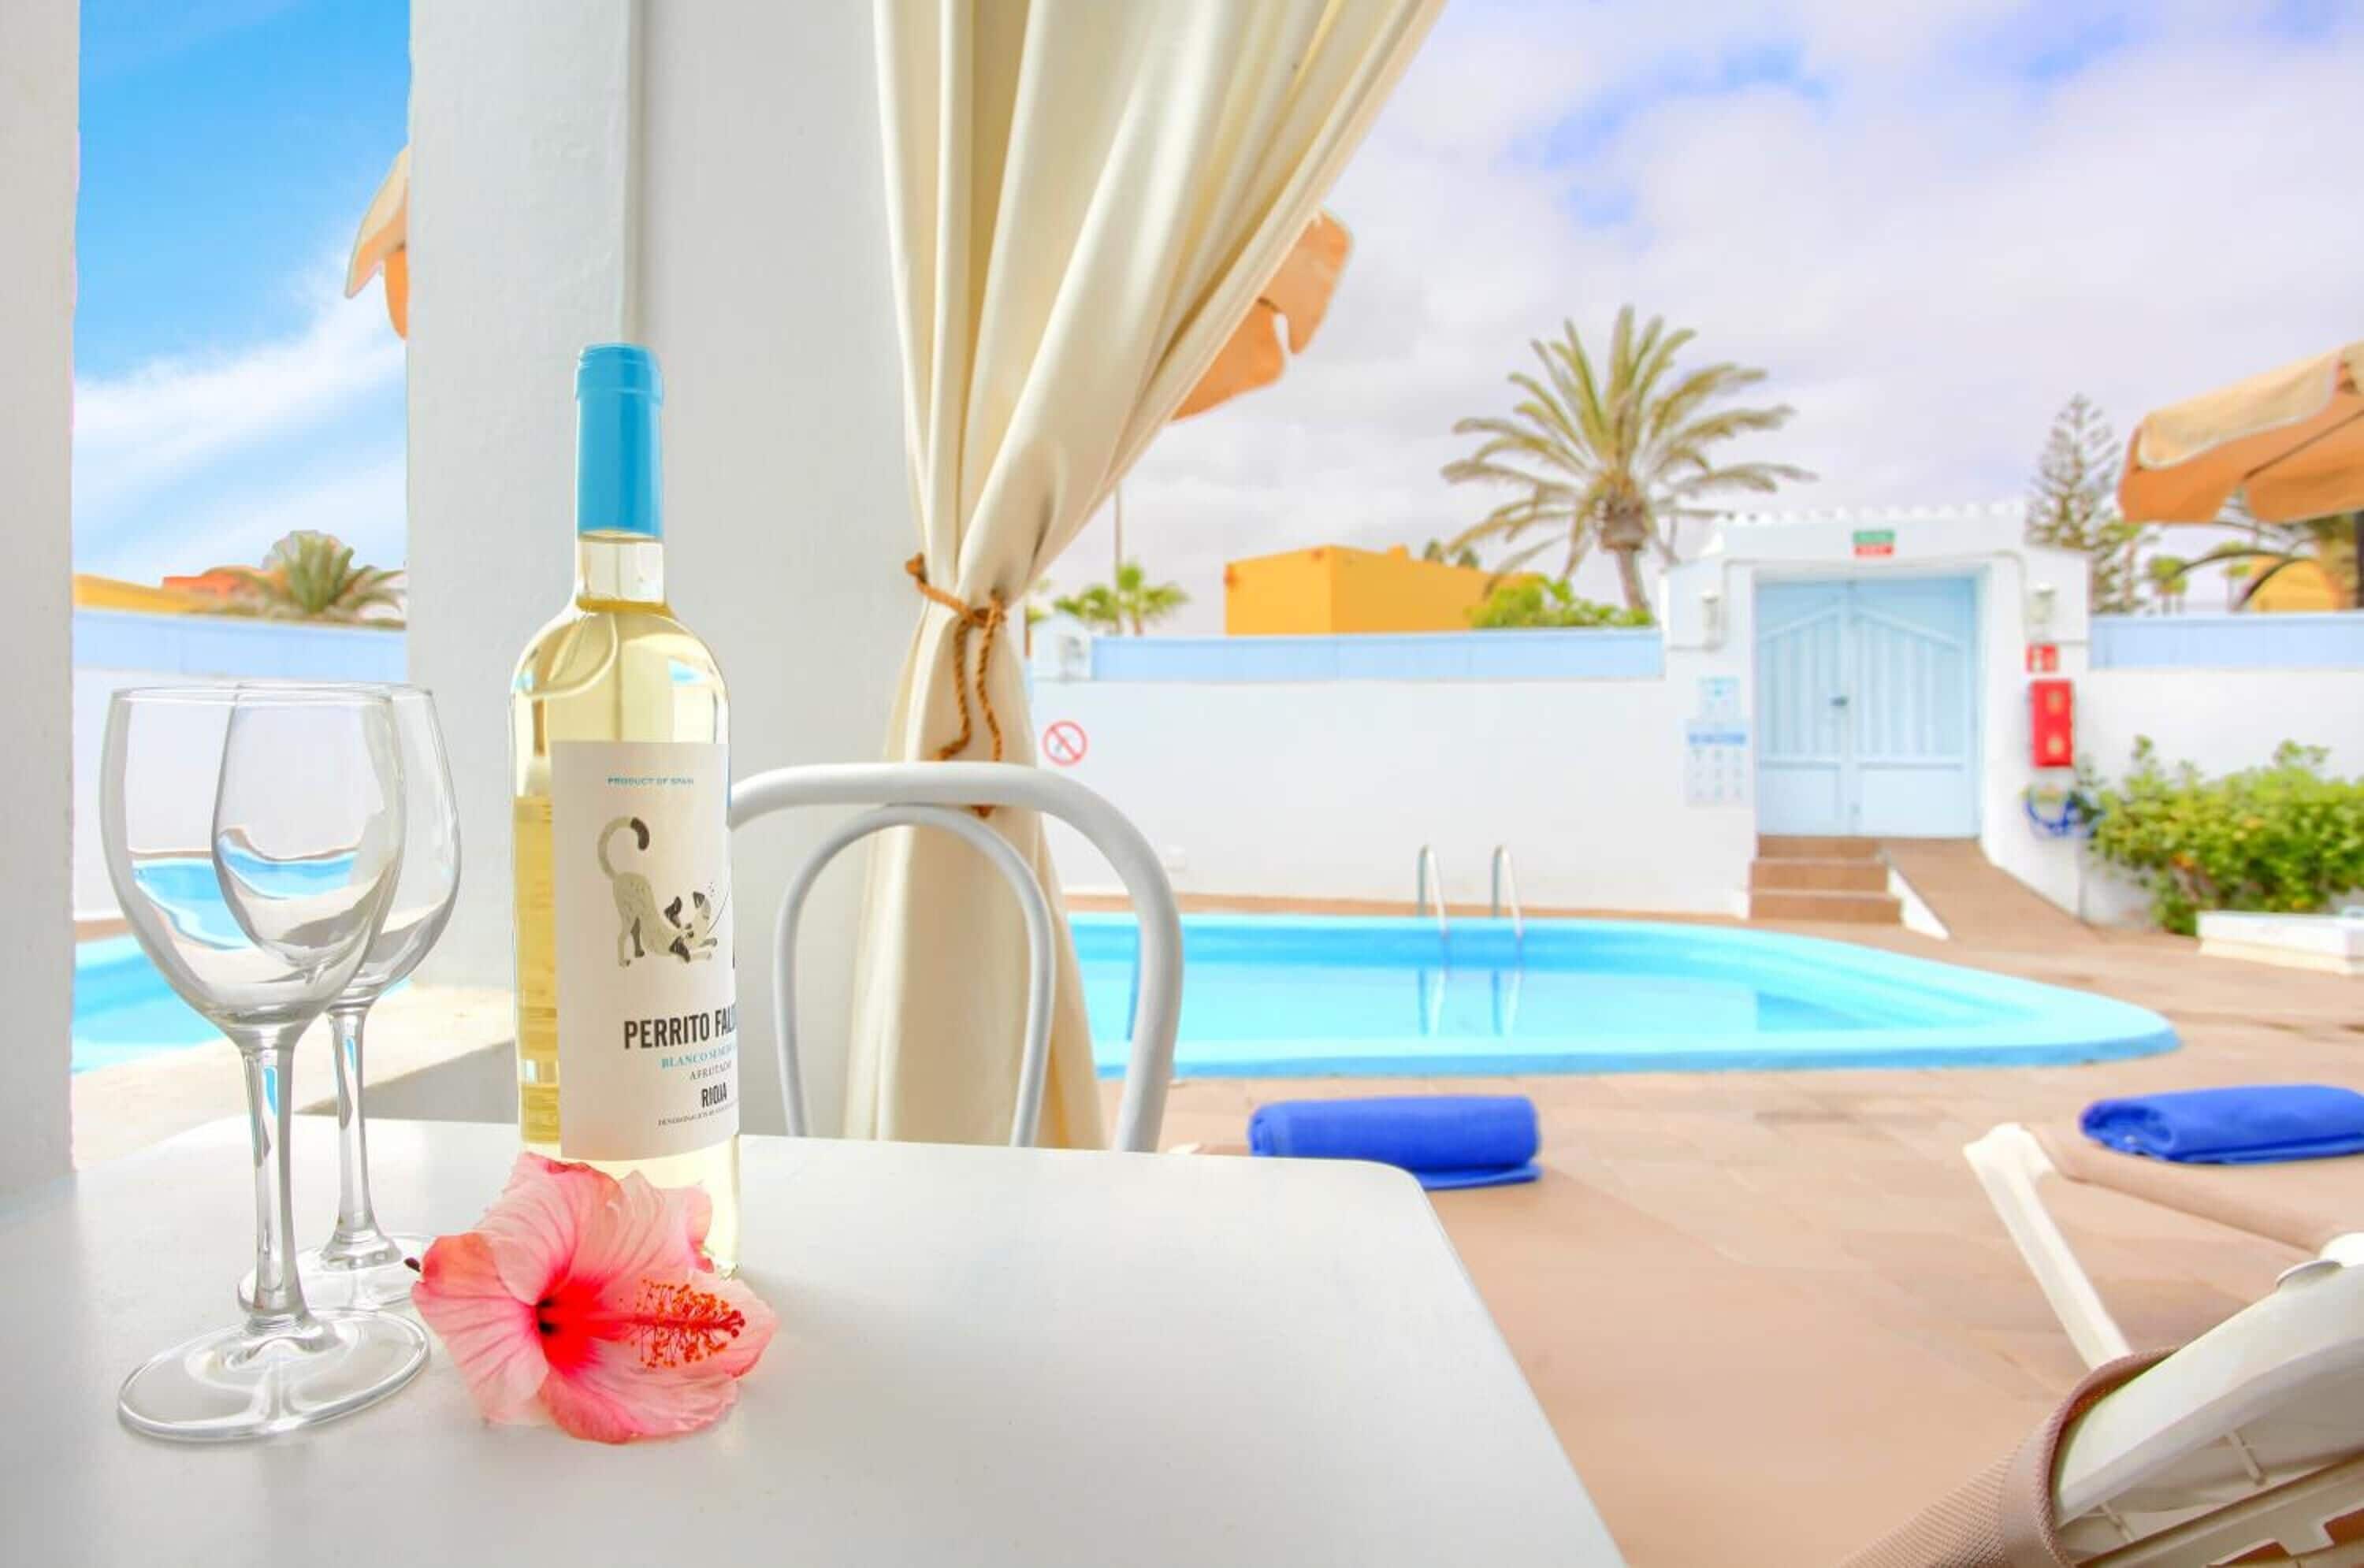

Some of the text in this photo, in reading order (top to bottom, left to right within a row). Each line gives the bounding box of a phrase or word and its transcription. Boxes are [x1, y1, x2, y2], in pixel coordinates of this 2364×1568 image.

[608, 776, 654, 786] PRODUCT
[624, 1012, 710, 1050] PERRITO
[661, 1052, 708, 1069] BLANCO
[701, 1082, 727, 1108] RIOJA
